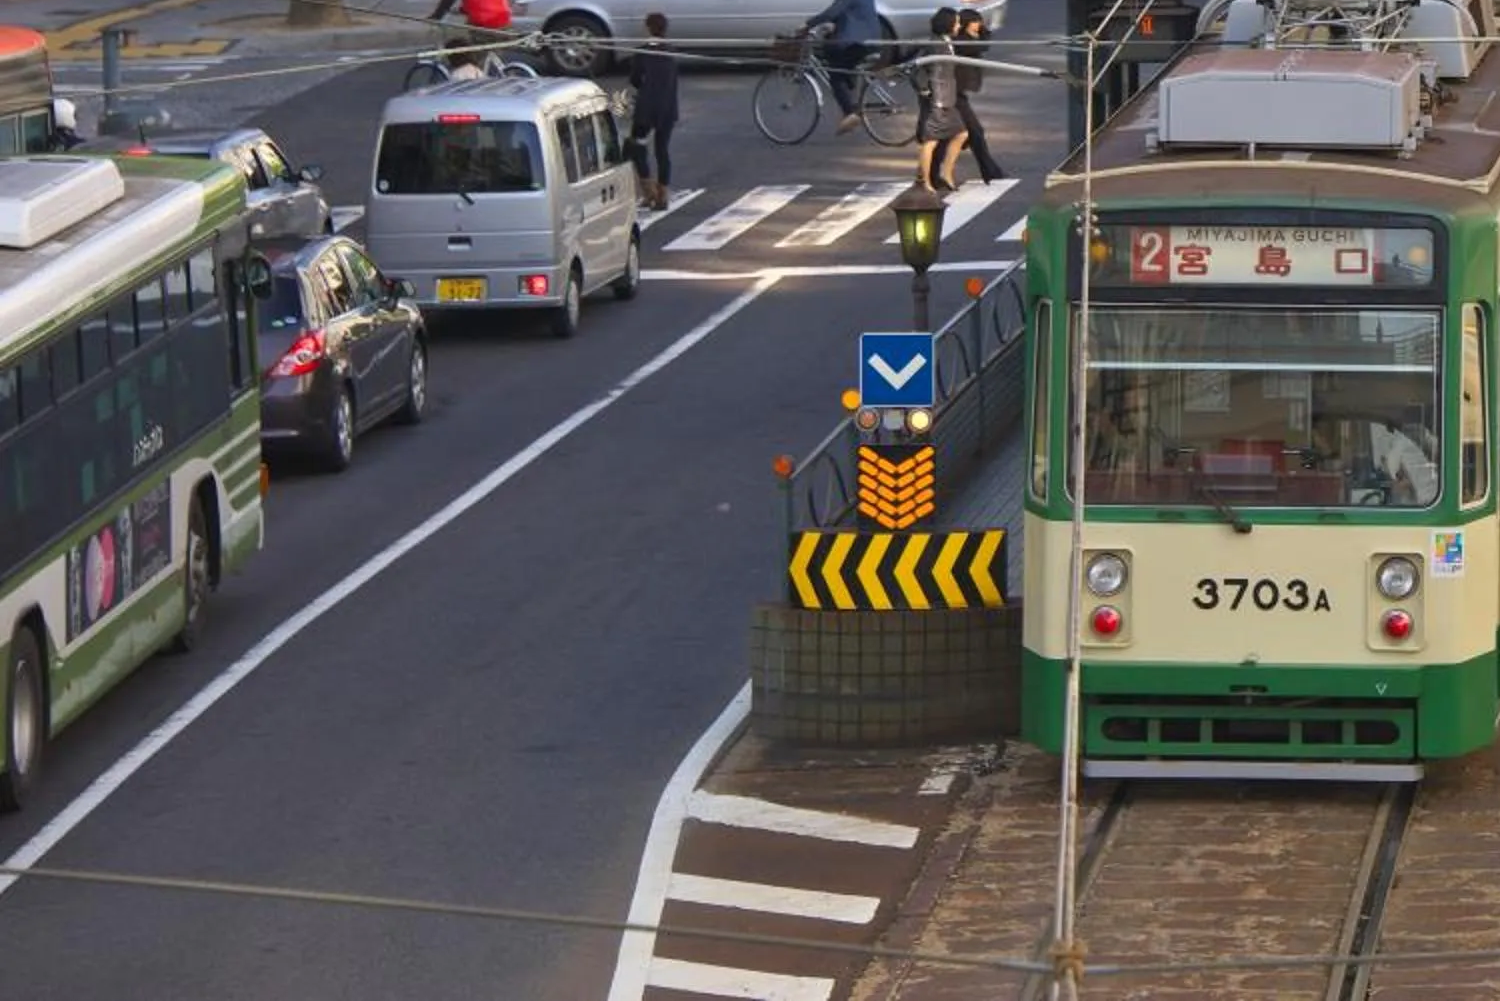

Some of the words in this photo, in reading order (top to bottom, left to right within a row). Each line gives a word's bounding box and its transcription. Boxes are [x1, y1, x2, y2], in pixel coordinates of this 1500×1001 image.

[1187, 227, 1285, 242] MIYAJIMA
[1292, 229, 1355, 242] GUCHI
[1139, 232, 1164, 272] 2
[1173, 244, 1369, 277] 宮島口
[1192, 578, 1332, 612] 3703A
